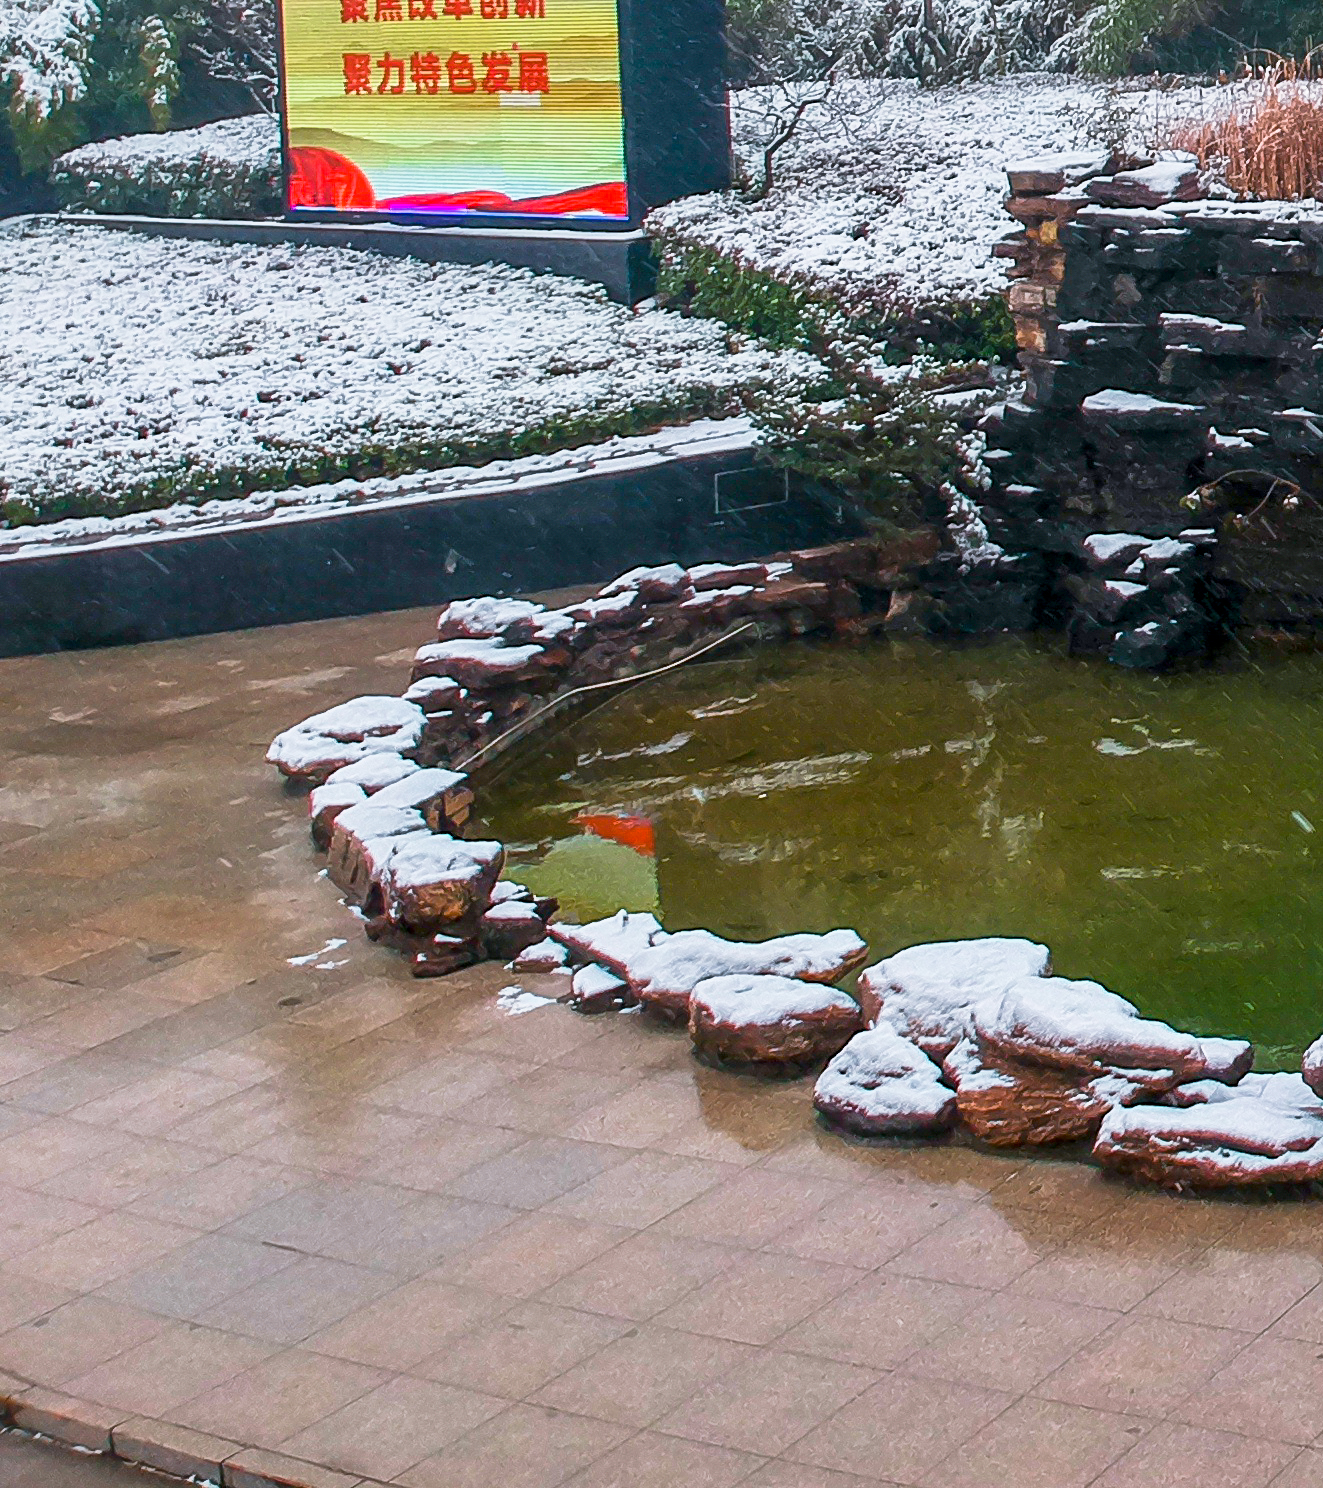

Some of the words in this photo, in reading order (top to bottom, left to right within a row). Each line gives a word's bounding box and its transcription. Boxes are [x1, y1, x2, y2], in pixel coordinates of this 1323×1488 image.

[342, 50, 550, 95] 聚力特色发展
